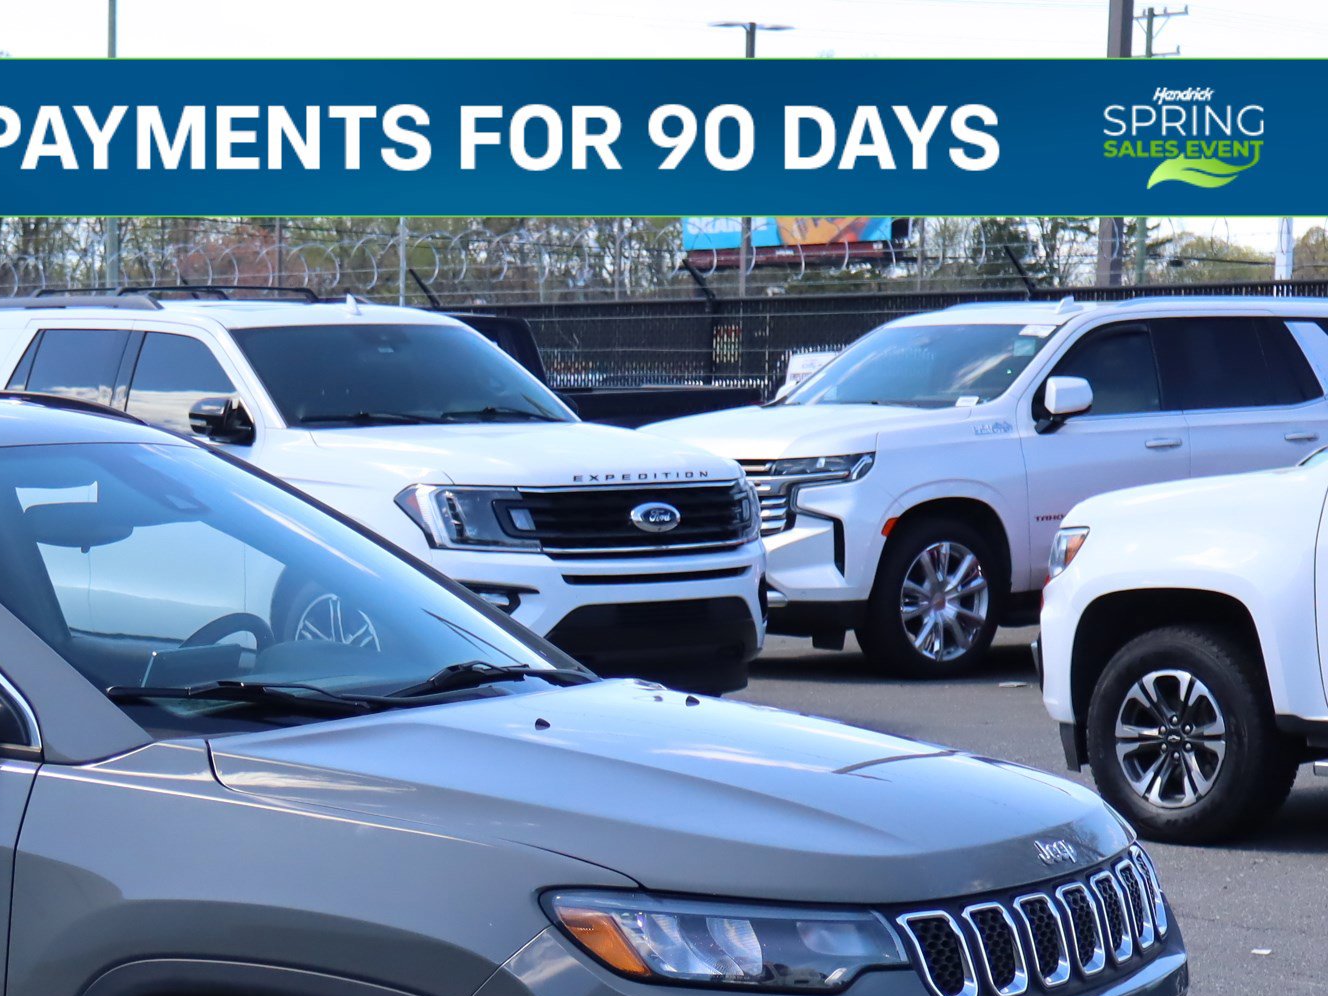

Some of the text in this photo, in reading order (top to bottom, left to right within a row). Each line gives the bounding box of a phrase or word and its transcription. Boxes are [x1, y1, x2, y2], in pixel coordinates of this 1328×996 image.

[573, 471, 708, 482] EXPEDITION
[649, 509, 671, 522] Ford
[1034, 839, 1077, 865] Jeep
